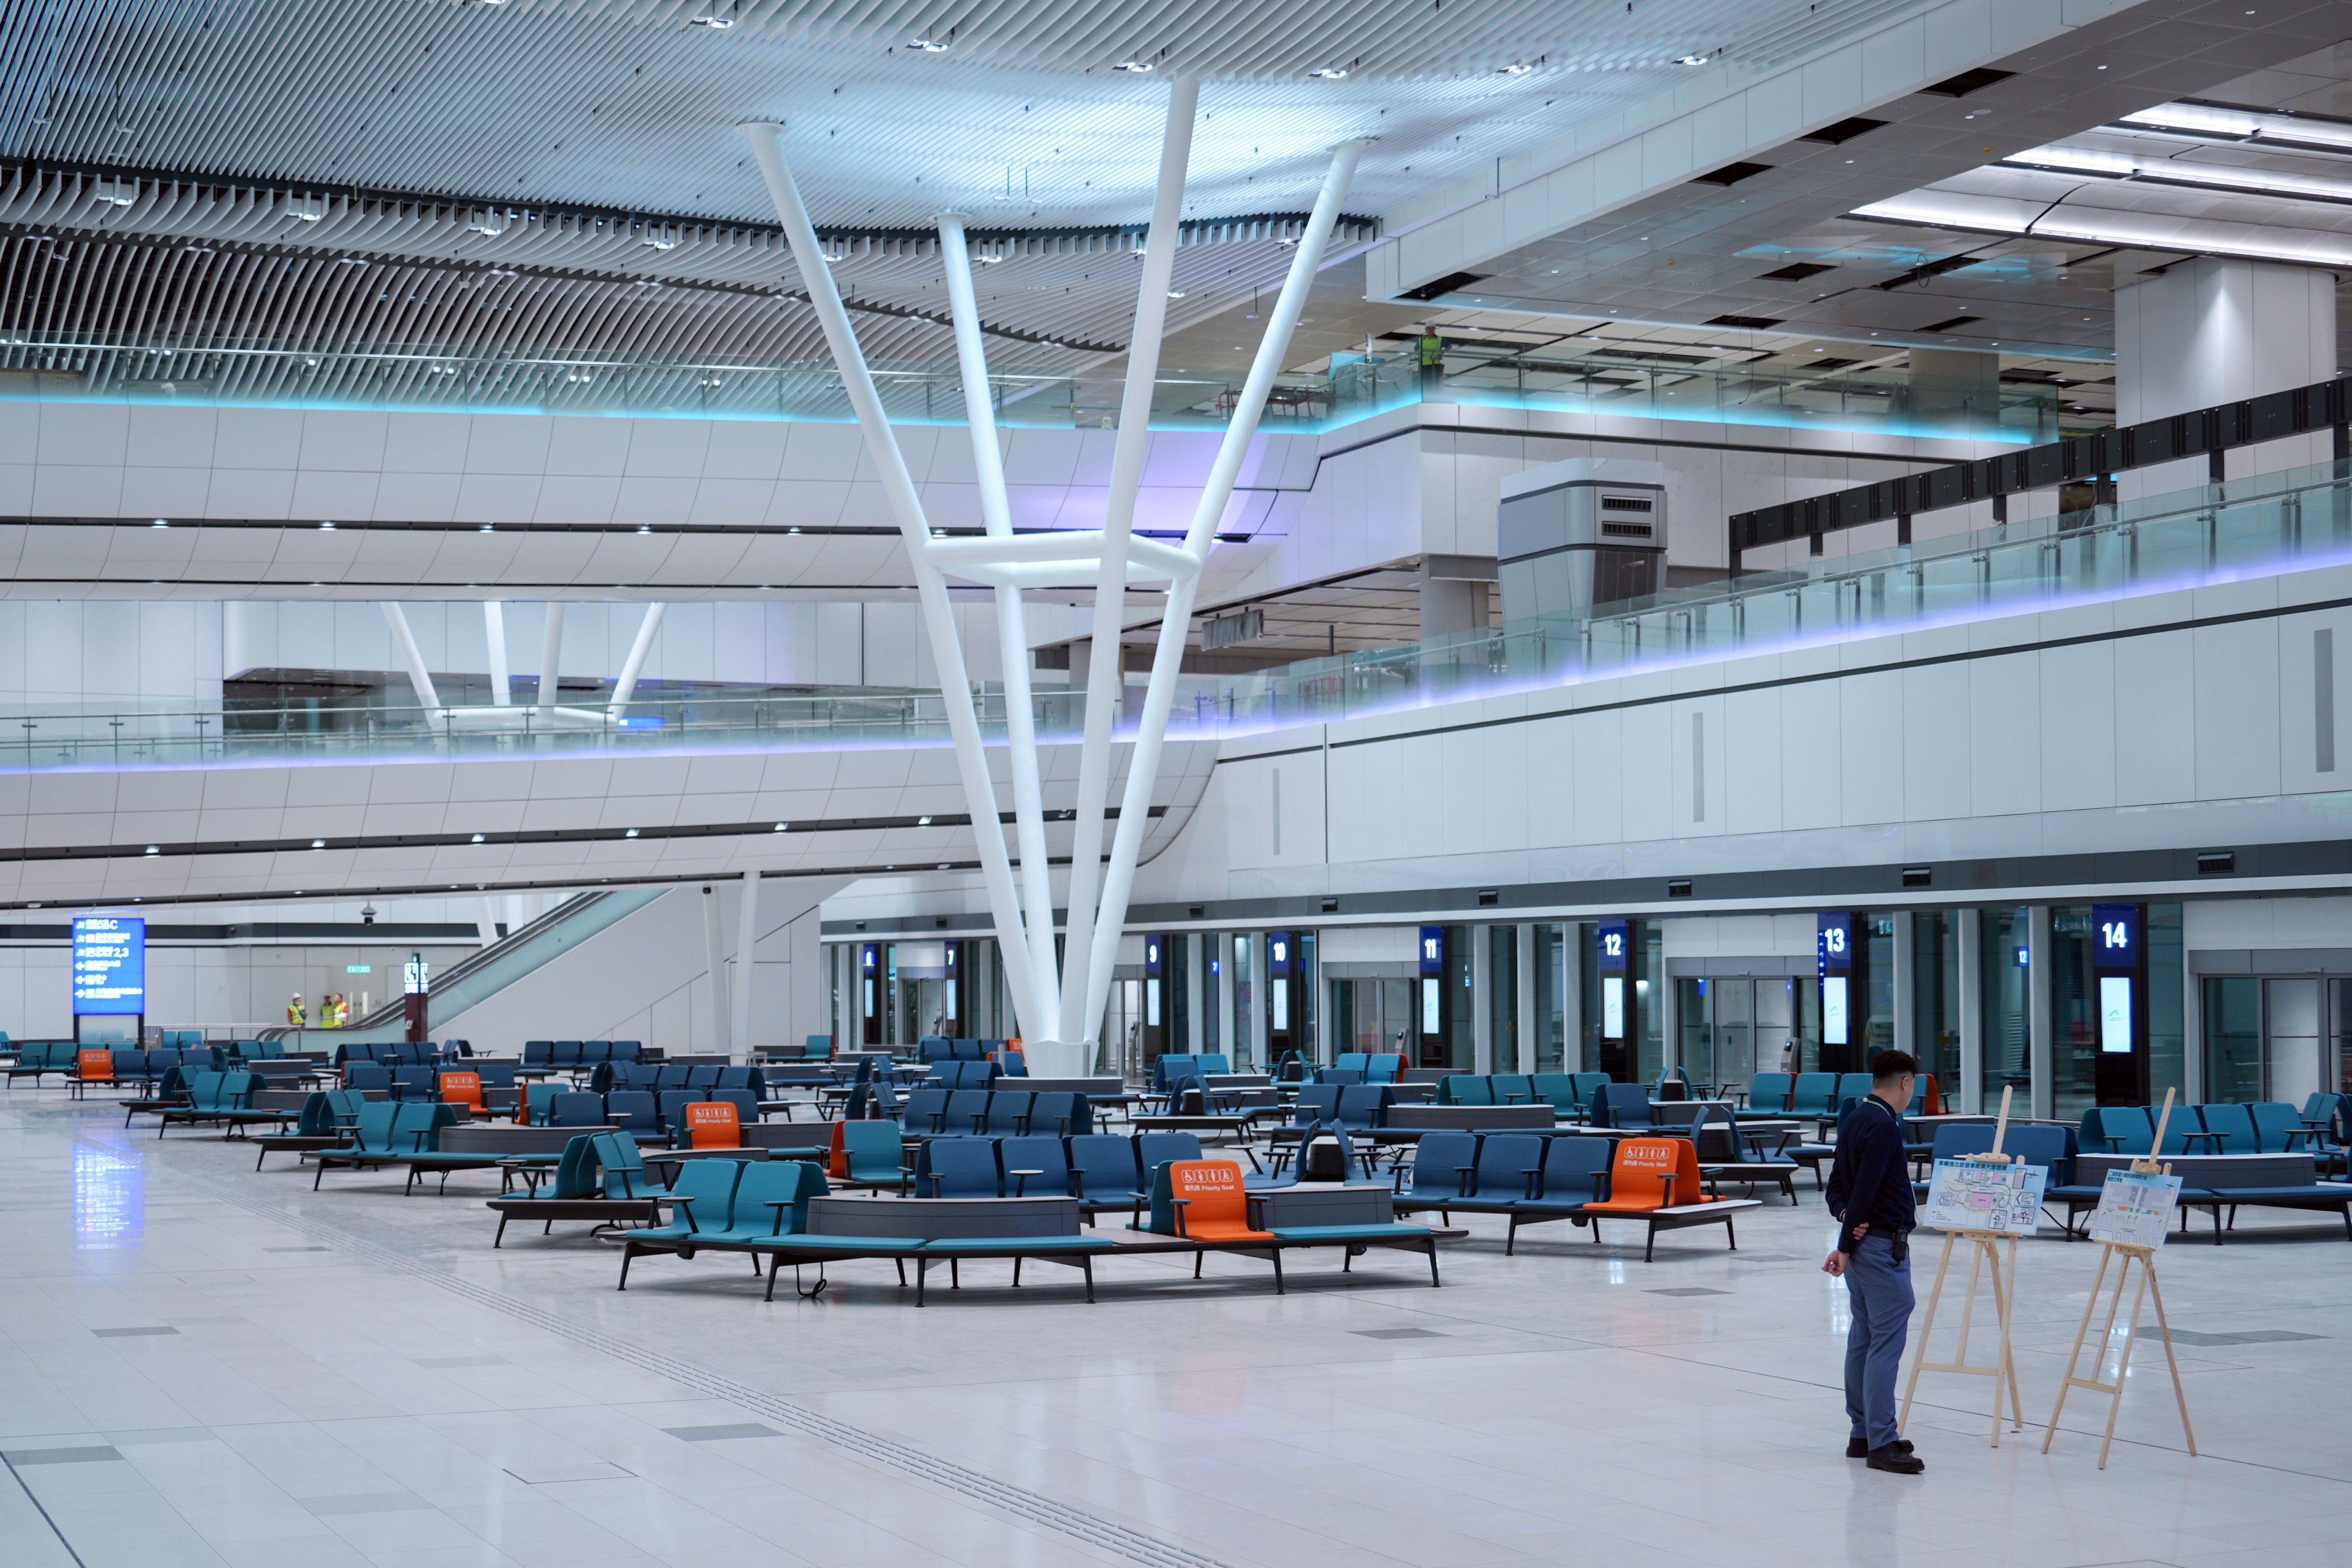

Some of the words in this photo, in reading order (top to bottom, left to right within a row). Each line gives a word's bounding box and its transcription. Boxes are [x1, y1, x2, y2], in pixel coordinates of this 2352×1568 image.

[110, 920, 118, 929] C
[1825, 928, 1845, 952] 13
[2102, 922, 2127, 948] 14
[1273, 942, 1286, 961] 10
[1424, 939, 1436, 959] 11
[1605, 933, 1621, 956] 12
[948, 949, 954, 965] 7
[1149, 945, 1157, 963] 9
[2018, 951, 2027, 963] 12
[1212, 962, 1218, 971] 7
